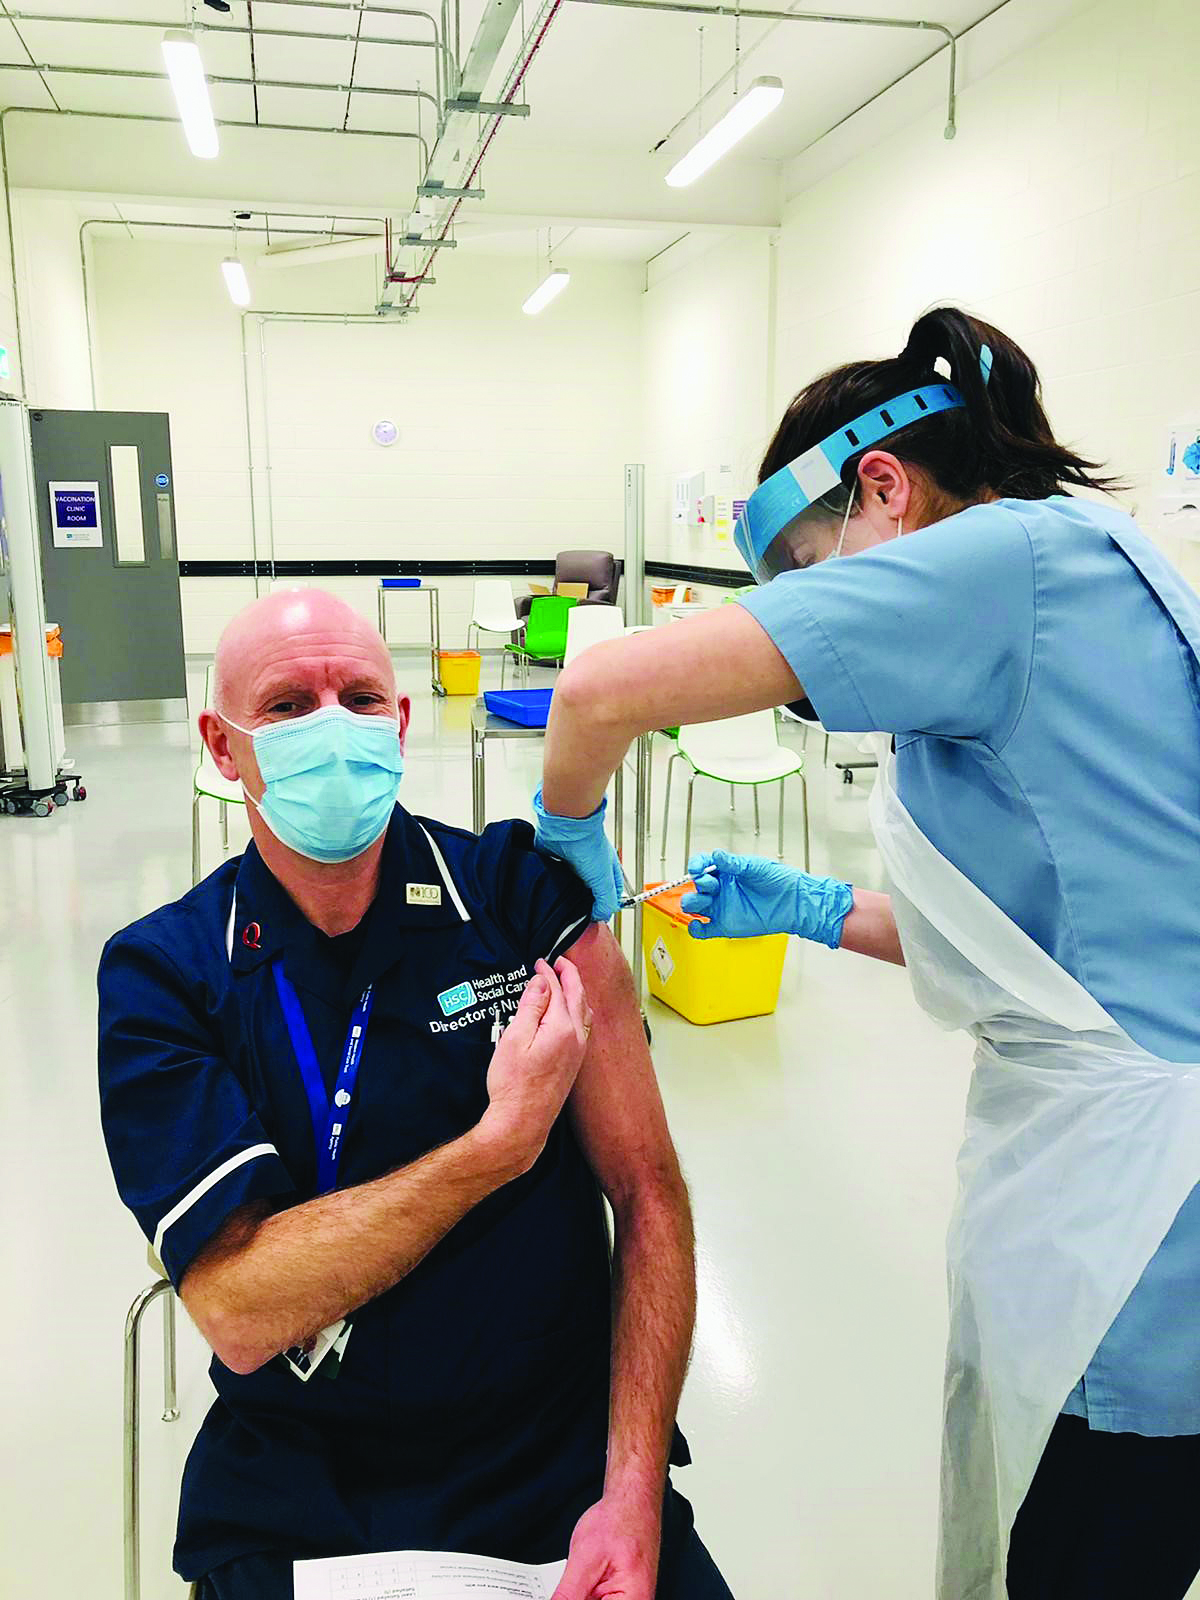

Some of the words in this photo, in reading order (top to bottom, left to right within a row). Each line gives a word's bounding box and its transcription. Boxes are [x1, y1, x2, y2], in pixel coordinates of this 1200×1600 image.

[472, 973, 505, 990] Health
[507, 964, 528, 981] and
[443, 990, 468, 1008] HSC
[477, 987, 505, 1002] Social
[429, 1008, 487, 1033] Director
[488, 1002, 501, 1016] of
[501, 998, 520, 1014] Nu
